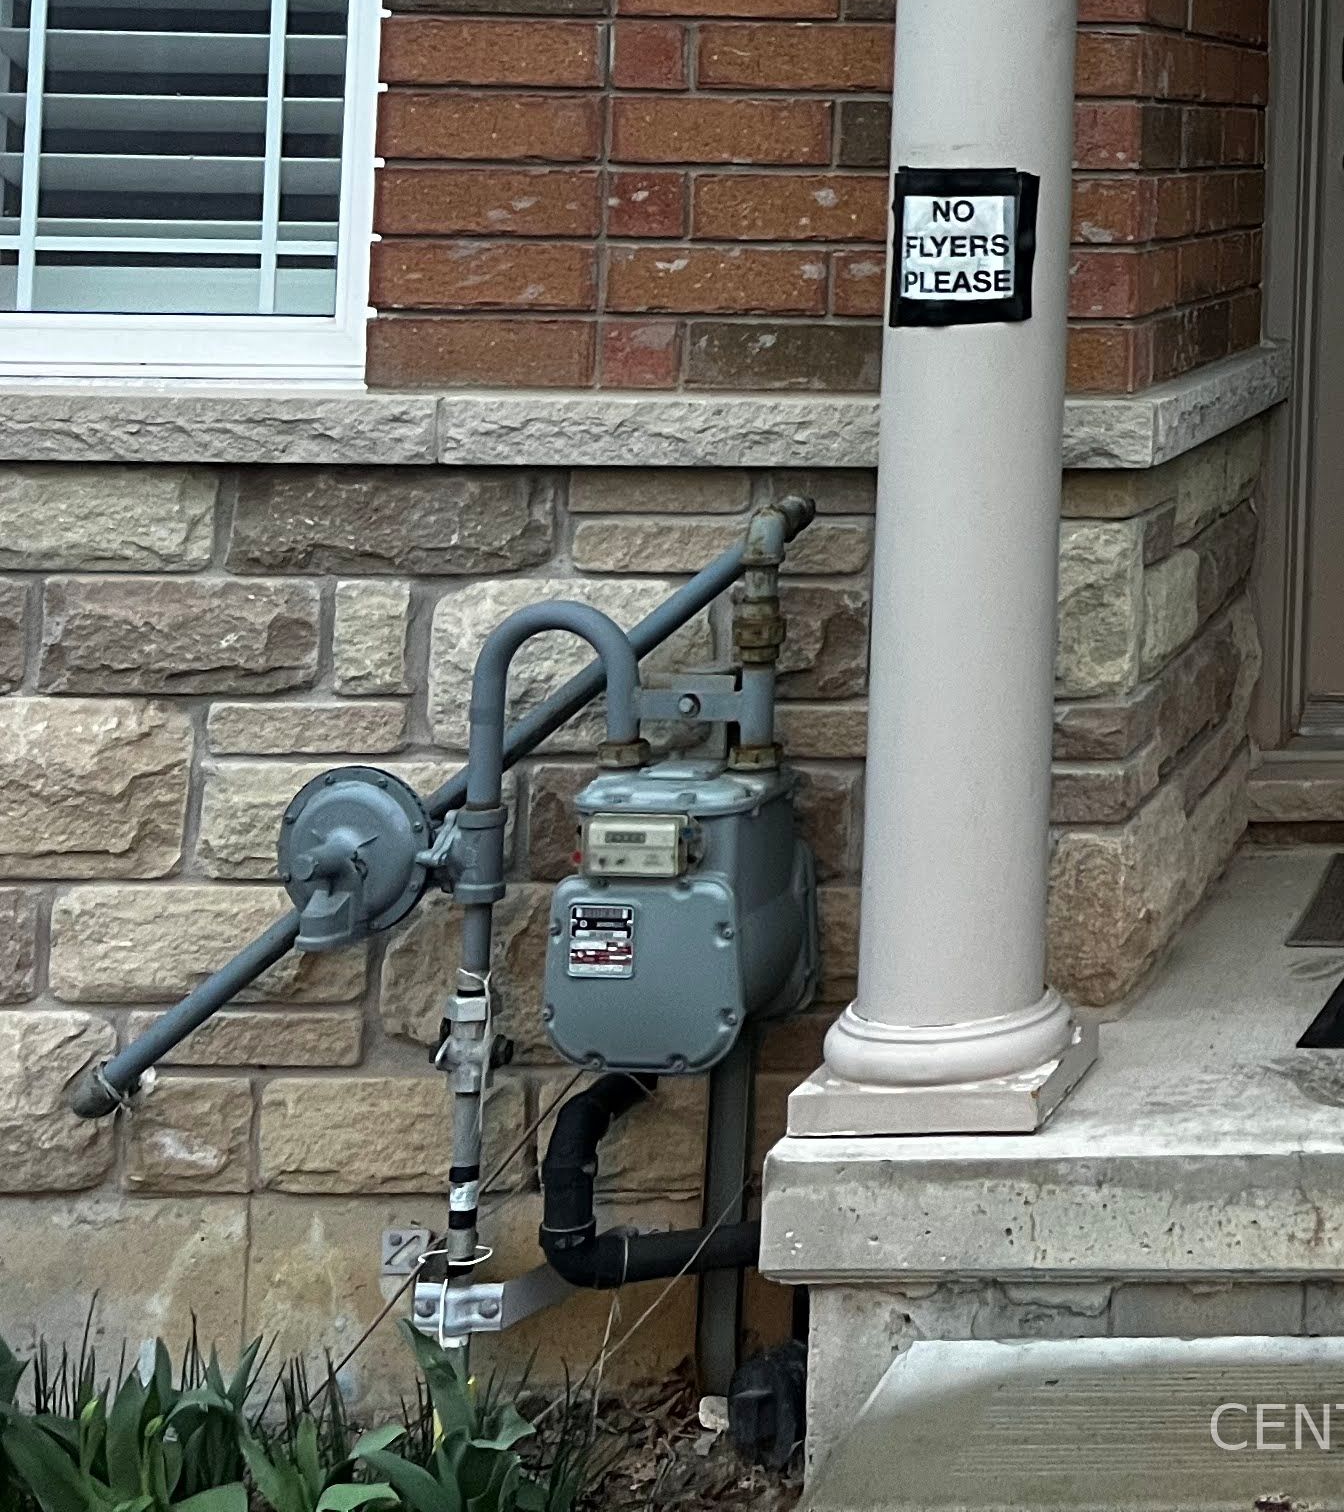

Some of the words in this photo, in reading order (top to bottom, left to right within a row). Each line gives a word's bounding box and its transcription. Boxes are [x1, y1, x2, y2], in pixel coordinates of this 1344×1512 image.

[932, 200, 975, 222] NO
[905, 234, 1010, 258] FLYERS
[904, 270, 1012, 293] PLEASE
